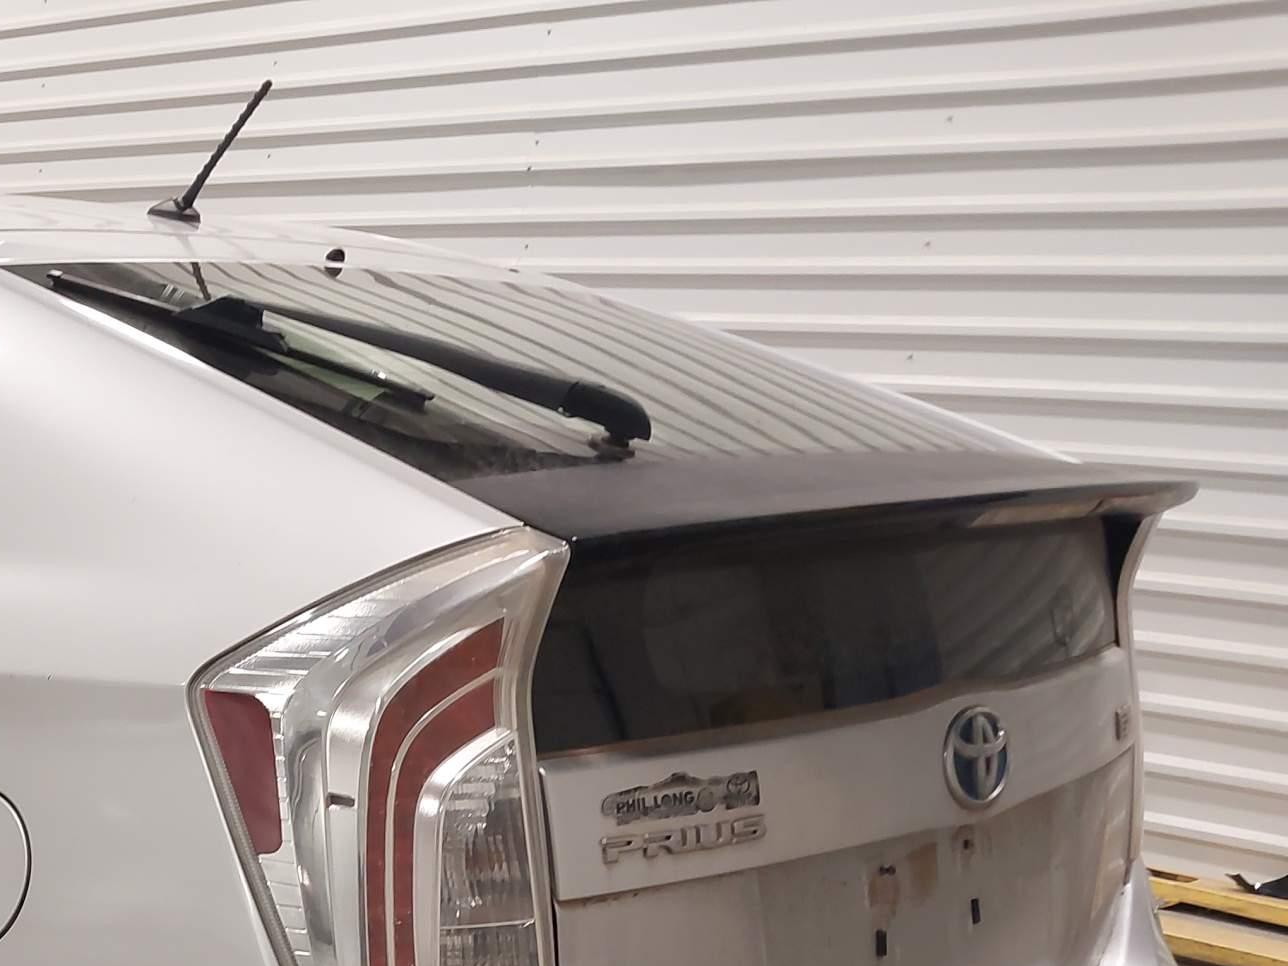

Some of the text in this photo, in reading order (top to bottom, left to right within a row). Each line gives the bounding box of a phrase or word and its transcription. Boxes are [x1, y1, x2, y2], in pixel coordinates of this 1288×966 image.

[615, 790, 695, 815] PHIL LONG
[600, 814, 767, 865] PRIUS
